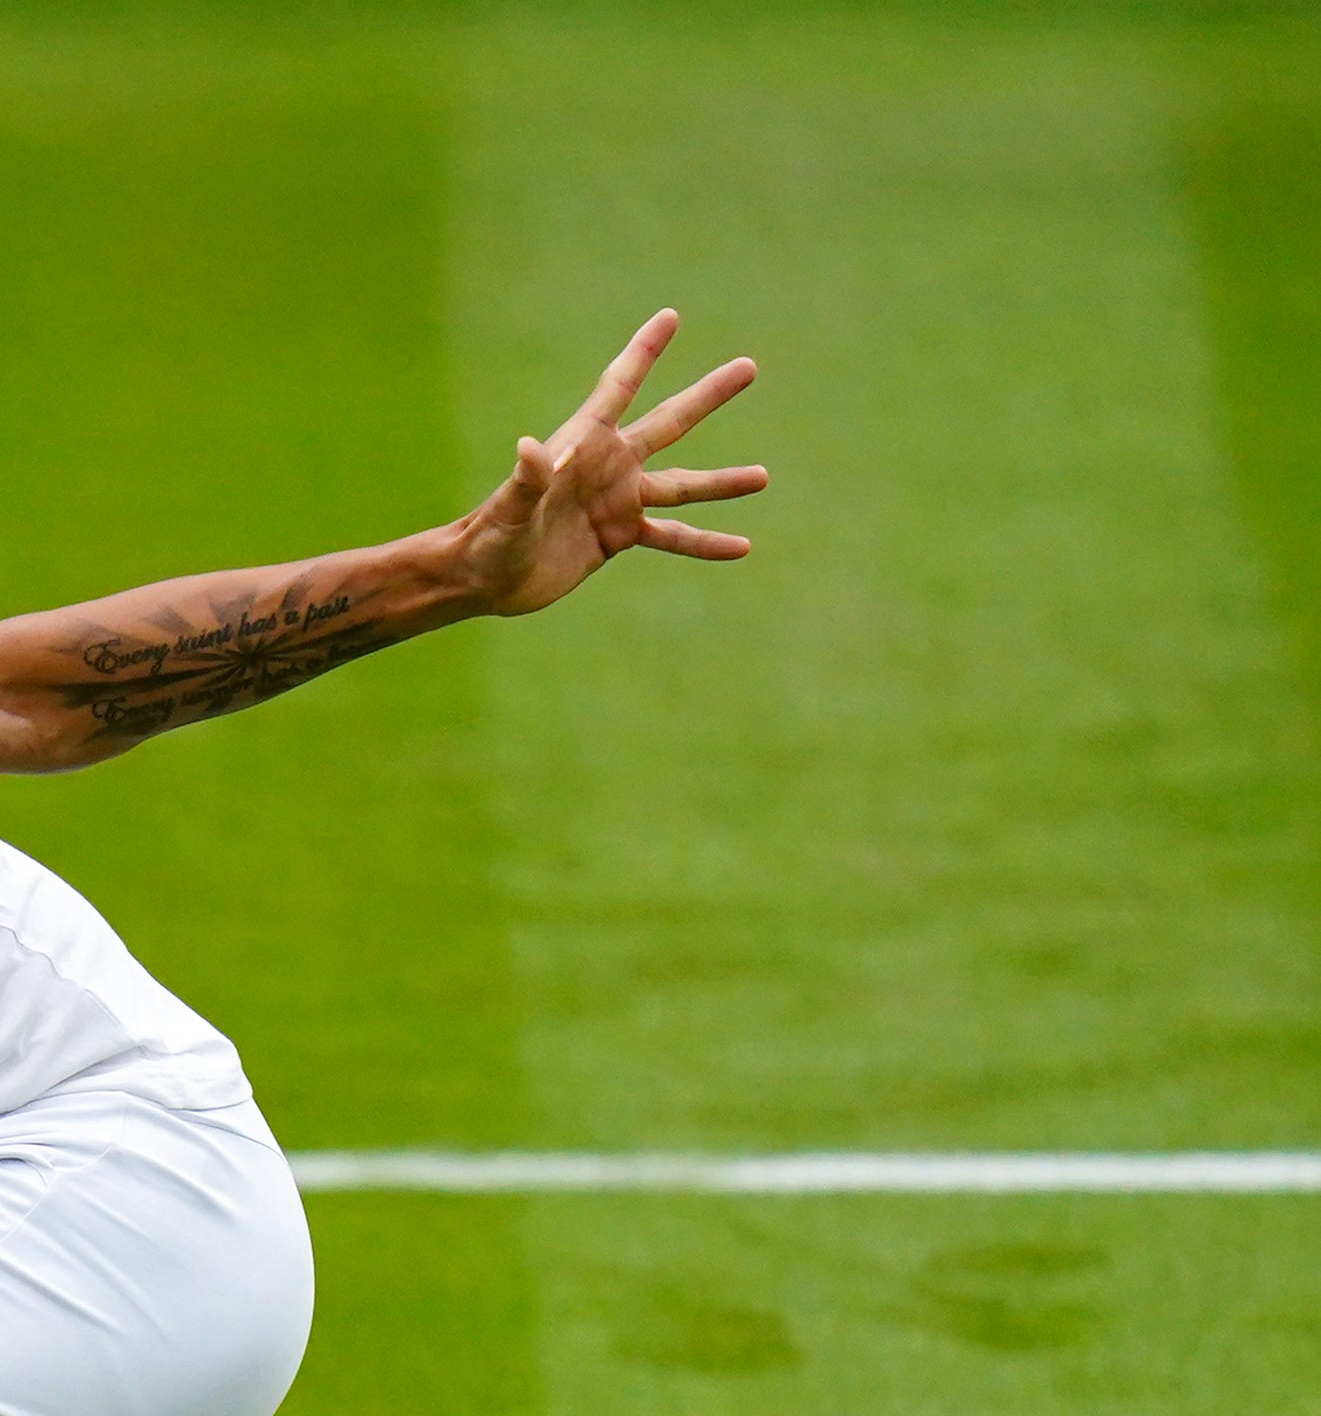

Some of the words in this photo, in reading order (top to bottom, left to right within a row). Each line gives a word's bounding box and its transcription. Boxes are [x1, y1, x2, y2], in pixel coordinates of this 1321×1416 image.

[83, 638, 170, 674] Every
[174, 624, 233, 653] saint
[237, 612, 277, 638] has
[284, 611, 300, 626] a
